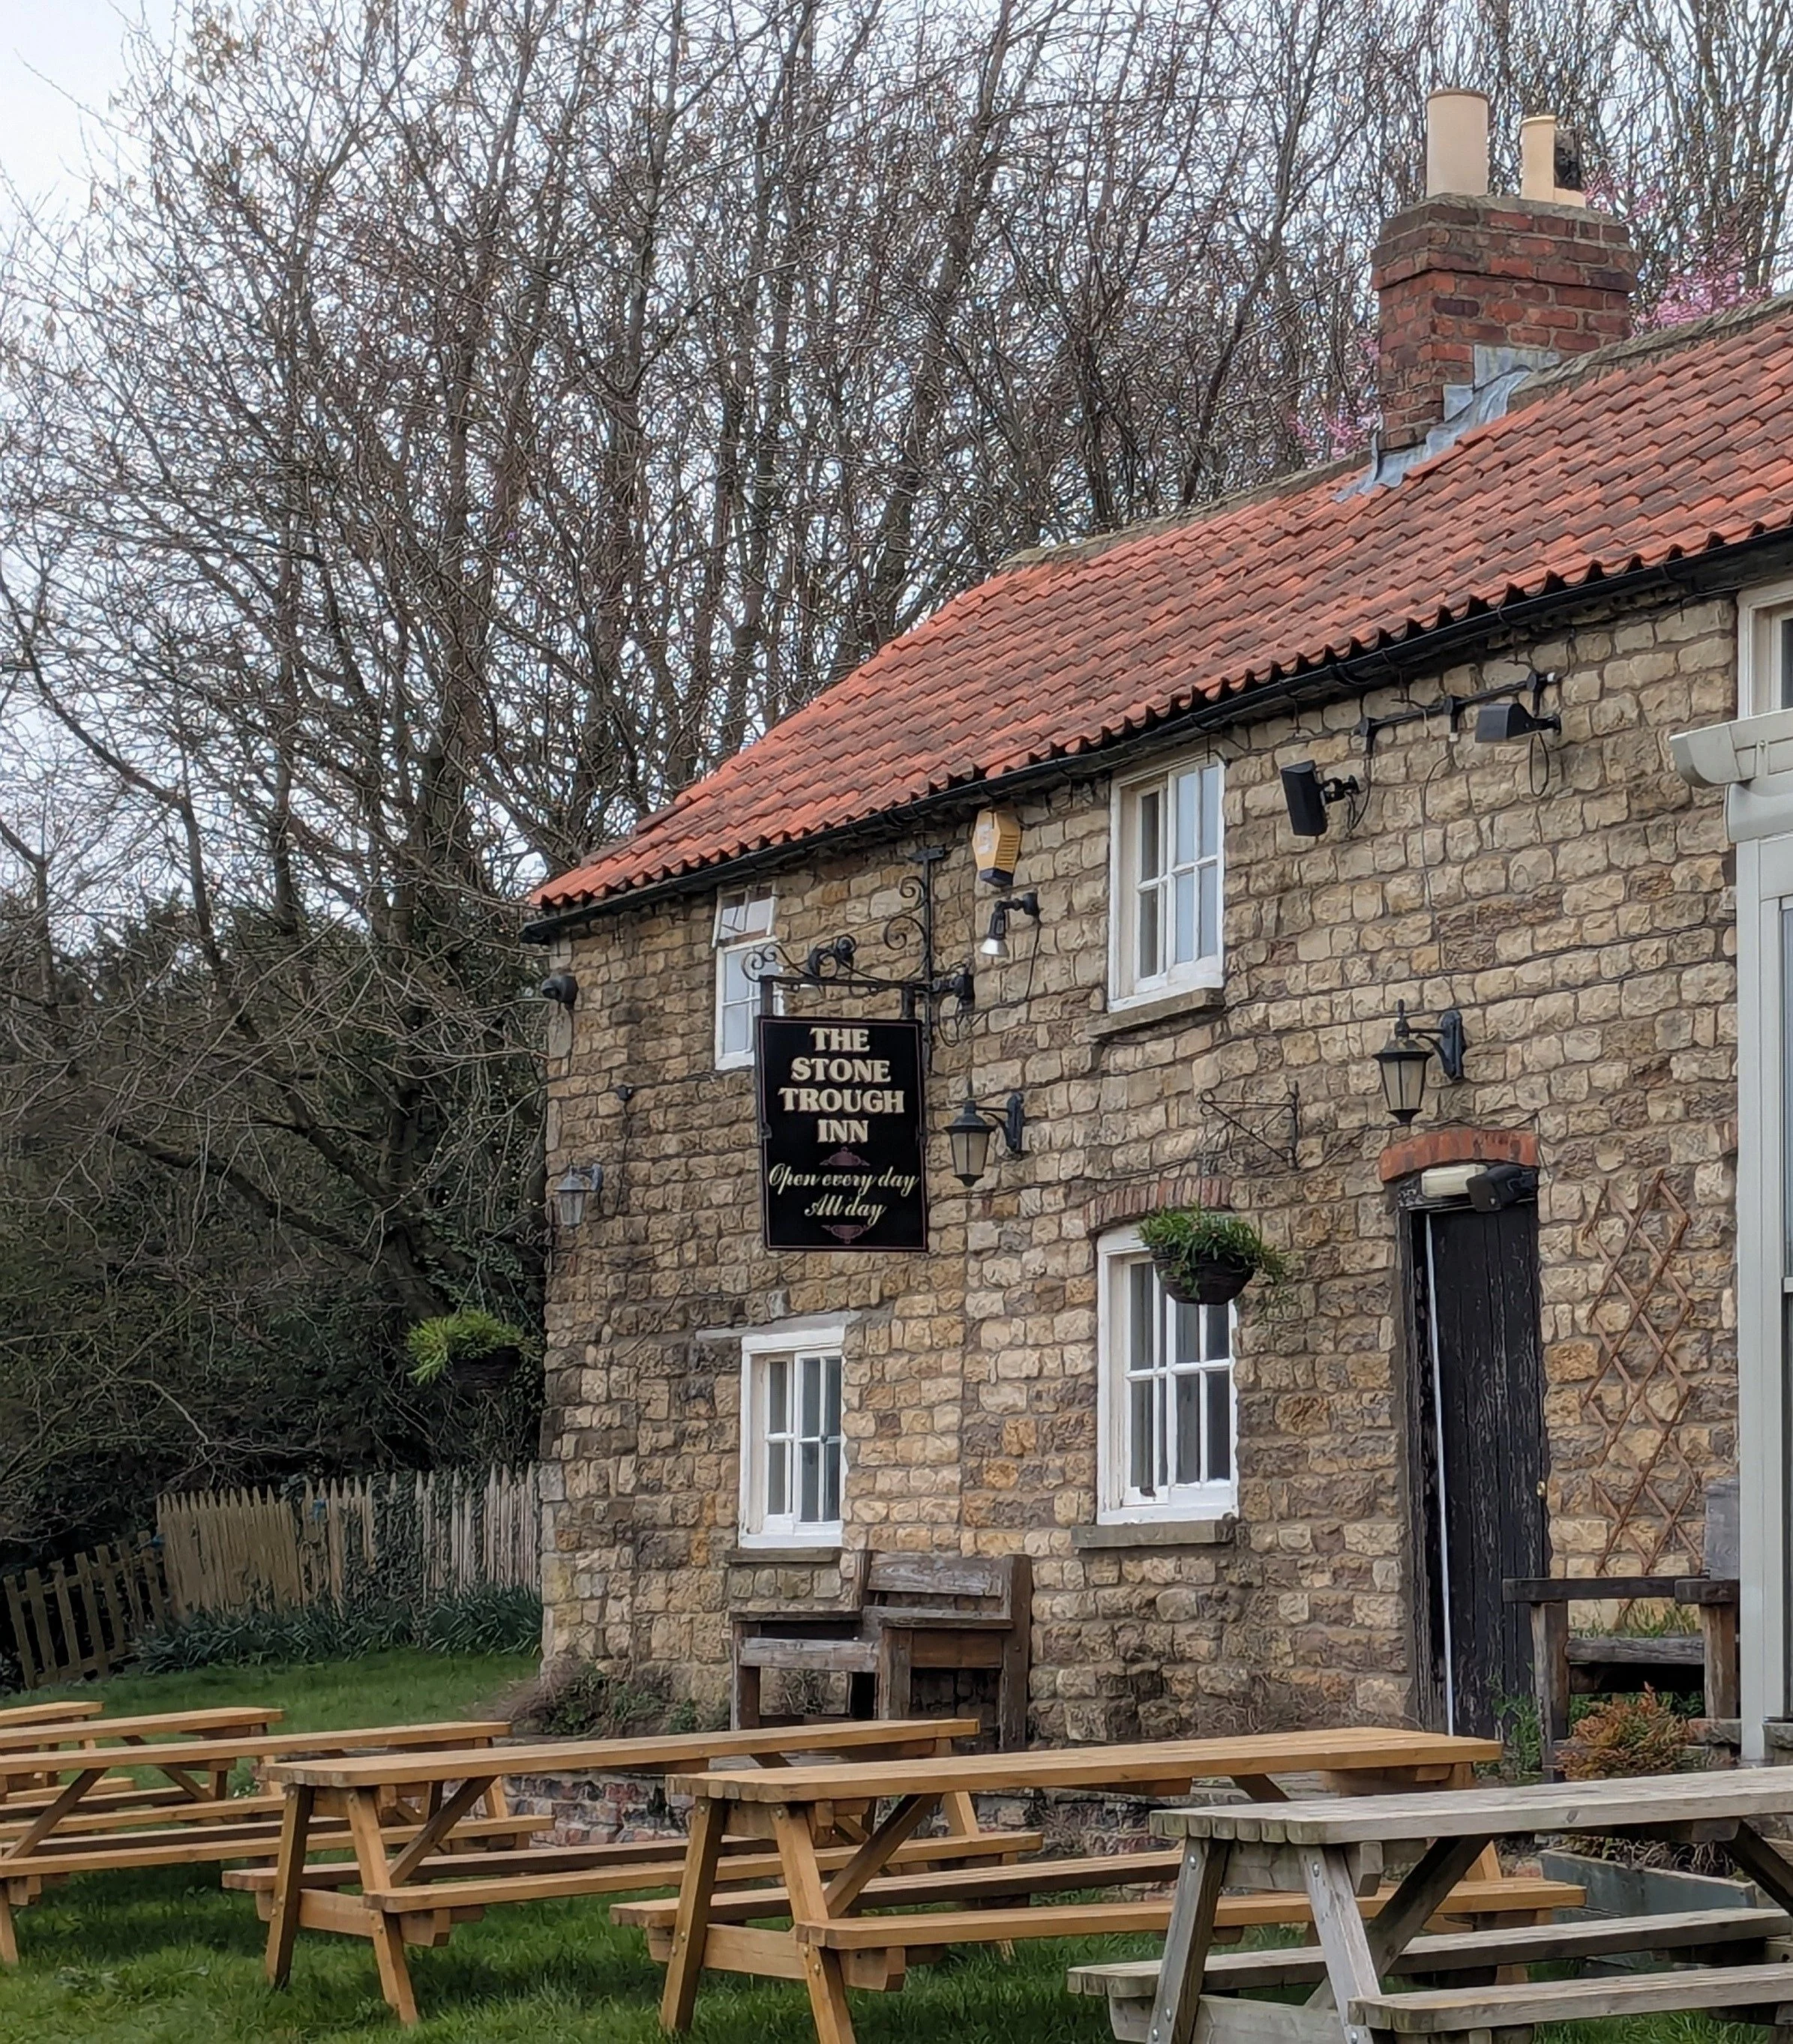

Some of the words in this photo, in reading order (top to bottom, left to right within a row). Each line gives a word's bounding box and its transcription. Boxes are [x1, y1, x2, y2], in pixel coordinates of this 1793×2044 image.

[811, 1027, 870, 1052] THE
[791, 1057, 891, 1083] STONE
[778, 1088, 904, 1113] TROUGH
[817, 1119, 869, 1143] INN
[769, 1164, 821, 1195] Open
[822, 1172, 879, 1196] every
[878, 1166, 919, 1197] day
[805, 1194, 846, 1216] All
[845, 1197, 886, 1226] day
